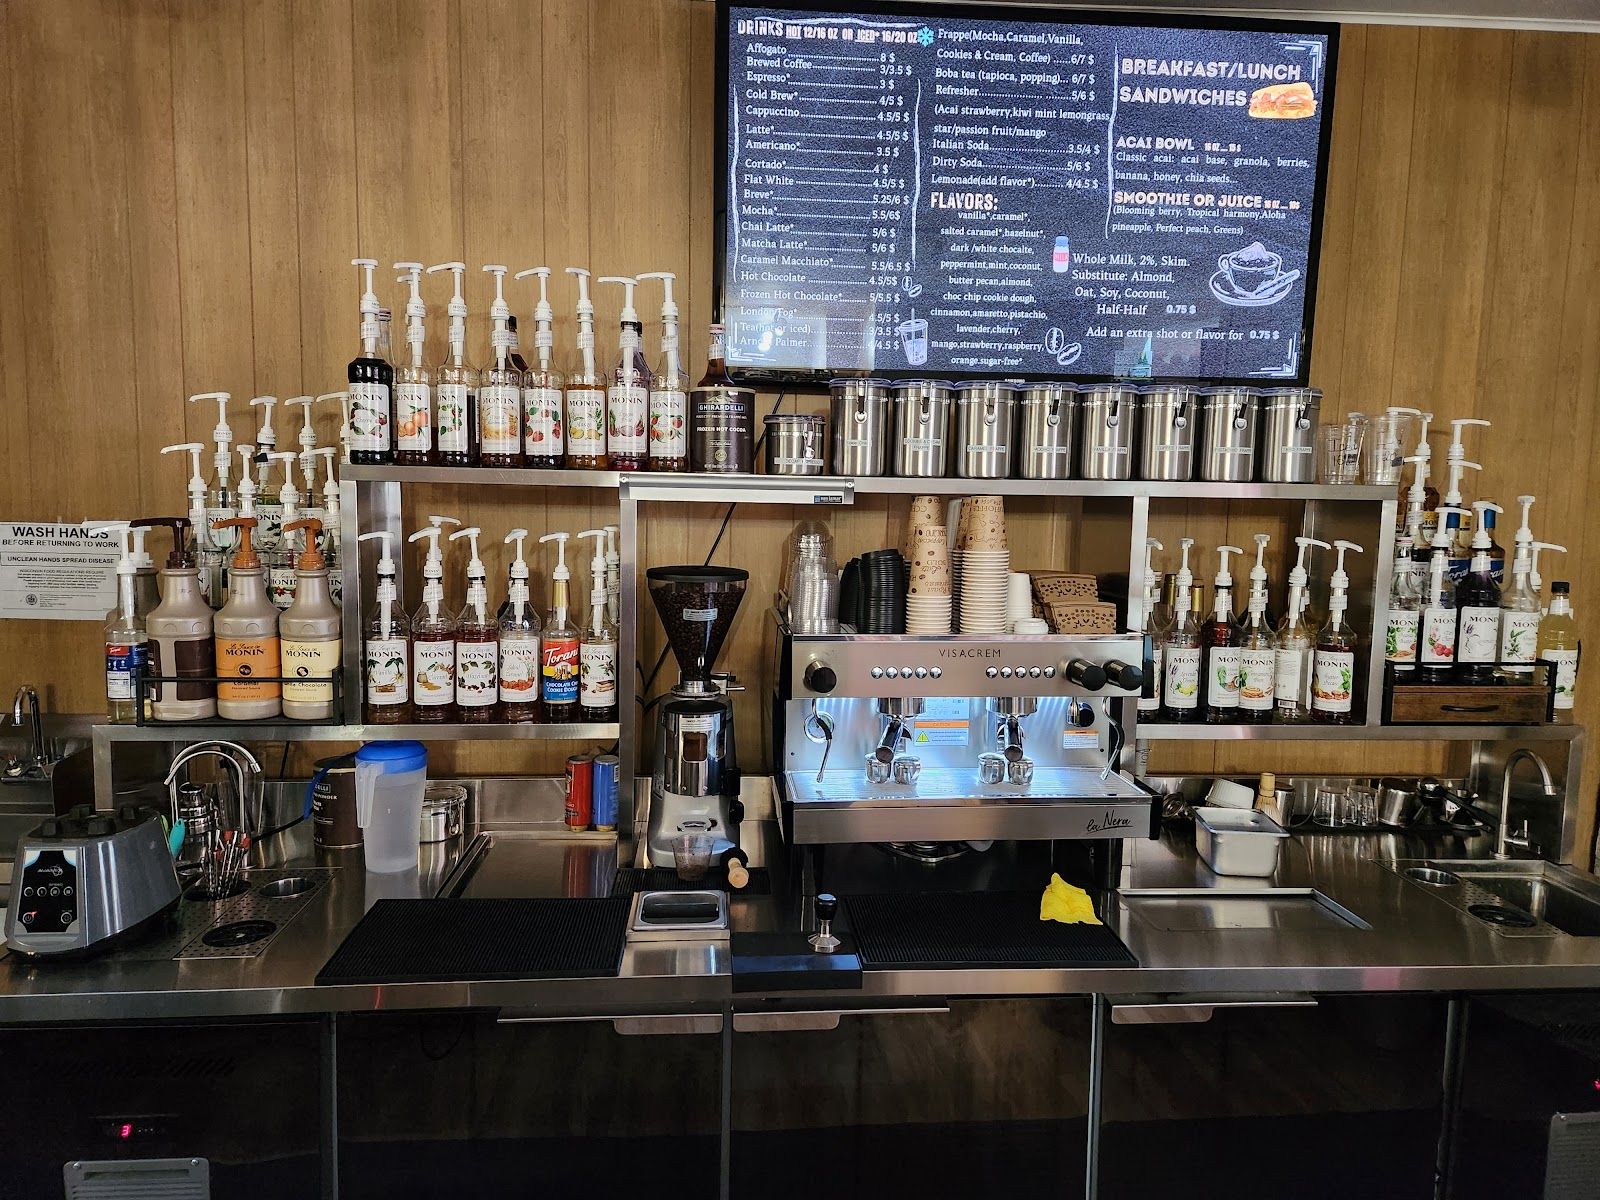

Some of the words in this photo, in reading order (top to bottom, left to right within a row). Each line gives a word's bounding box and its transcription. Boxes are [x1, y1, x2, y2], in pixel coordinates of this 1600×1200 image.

[738, 20, 783, 36] DRINKS
[803, 27, 826, 39] 12/16
[827, 28, 838, 39] OZ
[842, 28, 853, 40] OR
[882, 31, 905, 42] 16/20
[747, 43, 787, 56] Affogato
[747, 57, 780, 68] Brewed
[784, 58, 812, 69] Coffee
[937, 49, 972, 60] Cookies
[984, 51, 1016, 63] Cream,
[1019, 51, 1050, 64] Coffee)
[1071, 54, 1086, 65] 6/7
[1121, 58, 1301, 80] BREAKFAST/LUNCH
[936, 68, 959, 79] Boba
[962, 70, 975, 79] tea
[979, 70, 1017, 84] (tapioca,
[1072, 74, 1086, 84] 6/7
[746, 89, 767, 99] Cold
[879, 95, 894, 106] 4/5
[1119, 86, 1247, 106] SANDWICHES
[746, 105, 800, 119] Cappuccino
[877, 111, 900, 122] 4.5/5
[935, 105, 958, 116] (Acai
[1035, 109, 1056, 119] mint
[877, 130, 899, 141] 4.5/5
[934, 125, 988, 136] star/passion
[991, 125, 1046, 139] fruit/mango
[933, 139, 964, 149] Italian
[1116, 136, 1152, 149] ACAI
[1155, 137, 1195, 150] BOWL
[876, 147, 890, 157] 3.5
[933, 156, 957, 168] Dirty
[1116, 152, 1147, 162] Classic
[1181, 155, 1199, 164] acai
[1206, 155, 1228, 166] base,
[1234, 157, 1271, 168] granola,
[1277, 157, 1310, 168] berries,
[744, 174, 762, 184] Flat
[767, 175, 794, 185] White
[873, 178, 896, 188] 4.5/5
[931, 174, 997, 186] Lemonade(add
[1066, 179, 1090, 188] 4/4.5
[1115, 170, 1150, 181] banana,
[1153, 172, 1183, 184] honey,
[1185, 173, 1204, 182] chia
[931, 192, 998, 210] FLAVORS:
[1114, 192, 1190, 206] SMOOTHIE
[1194, 194, 1214, 207] OR
[1218, 195, 1262, 208] JUICE
[1113, 205, 1155, 217] (Blooming
[1158, 208, 1183, 218] berry,
[1186, 208, 1220, 218] Tropical
[742, 221, 762, 231] Chai
[941, 226, 964, 236] salted
[1112, 223, 1153, 234] pineapple,
[1156, 224, 1183, 233] Perfect
[1186, 225, 1211, 235] peach,
[1213, 226, 1244, 236] Greens)
[742, 238, 777, 249] Matcha
[951, 243, 969, 252] dark
[971, 244, 997, 253] /white
[741, 255, 778, 265] Caramel
[1072, 253, 1106, 264] Whole
[1109, 254, 1136, 266] Milk,
[1139, 255, 1158, 267] 2%,
[741, 271, 758, 281] Hot
[761, 272, 806, 283] Chocolate
[949, 276, 973, 285] butter
[1072, 270, 1128, 281] Substitute:
[1131, 272, 1175, 284] Almond,
[741, 289, 770, 299] Frozen
[774, 290, 792, 300] Hot
[943, 292, 962, 300] choc
[964, 292, 981, 303] chip
[983, 293, 1008, 302] cookie
[1010, 294, 1037, 305] dough,
[1075, 287, 1097, 299] Oat,
[1100, 288, 1121, 300] Soy,
[1125, 288, 1169, 300] Coconut,
[1097, 304, 1148, 315] Half-Half
[1166, 305, 1187, 314] 0.75
[1086, 327, 1107, 338] Add
[1110, 329, 1123, 338] an
[1127, 329, 1153, 339] extra
[1156, 328, 1179, 339] shot
[1181, 331, 1193, 339] or
[1196, 329, 1225, 340] flavor
[1228, 330, 1244, 340] for
[1250, 331, 1271, 340] 0.75
[12, 526, 54, 537] WASH
[939, 648, 1001, 659] VISACREM
